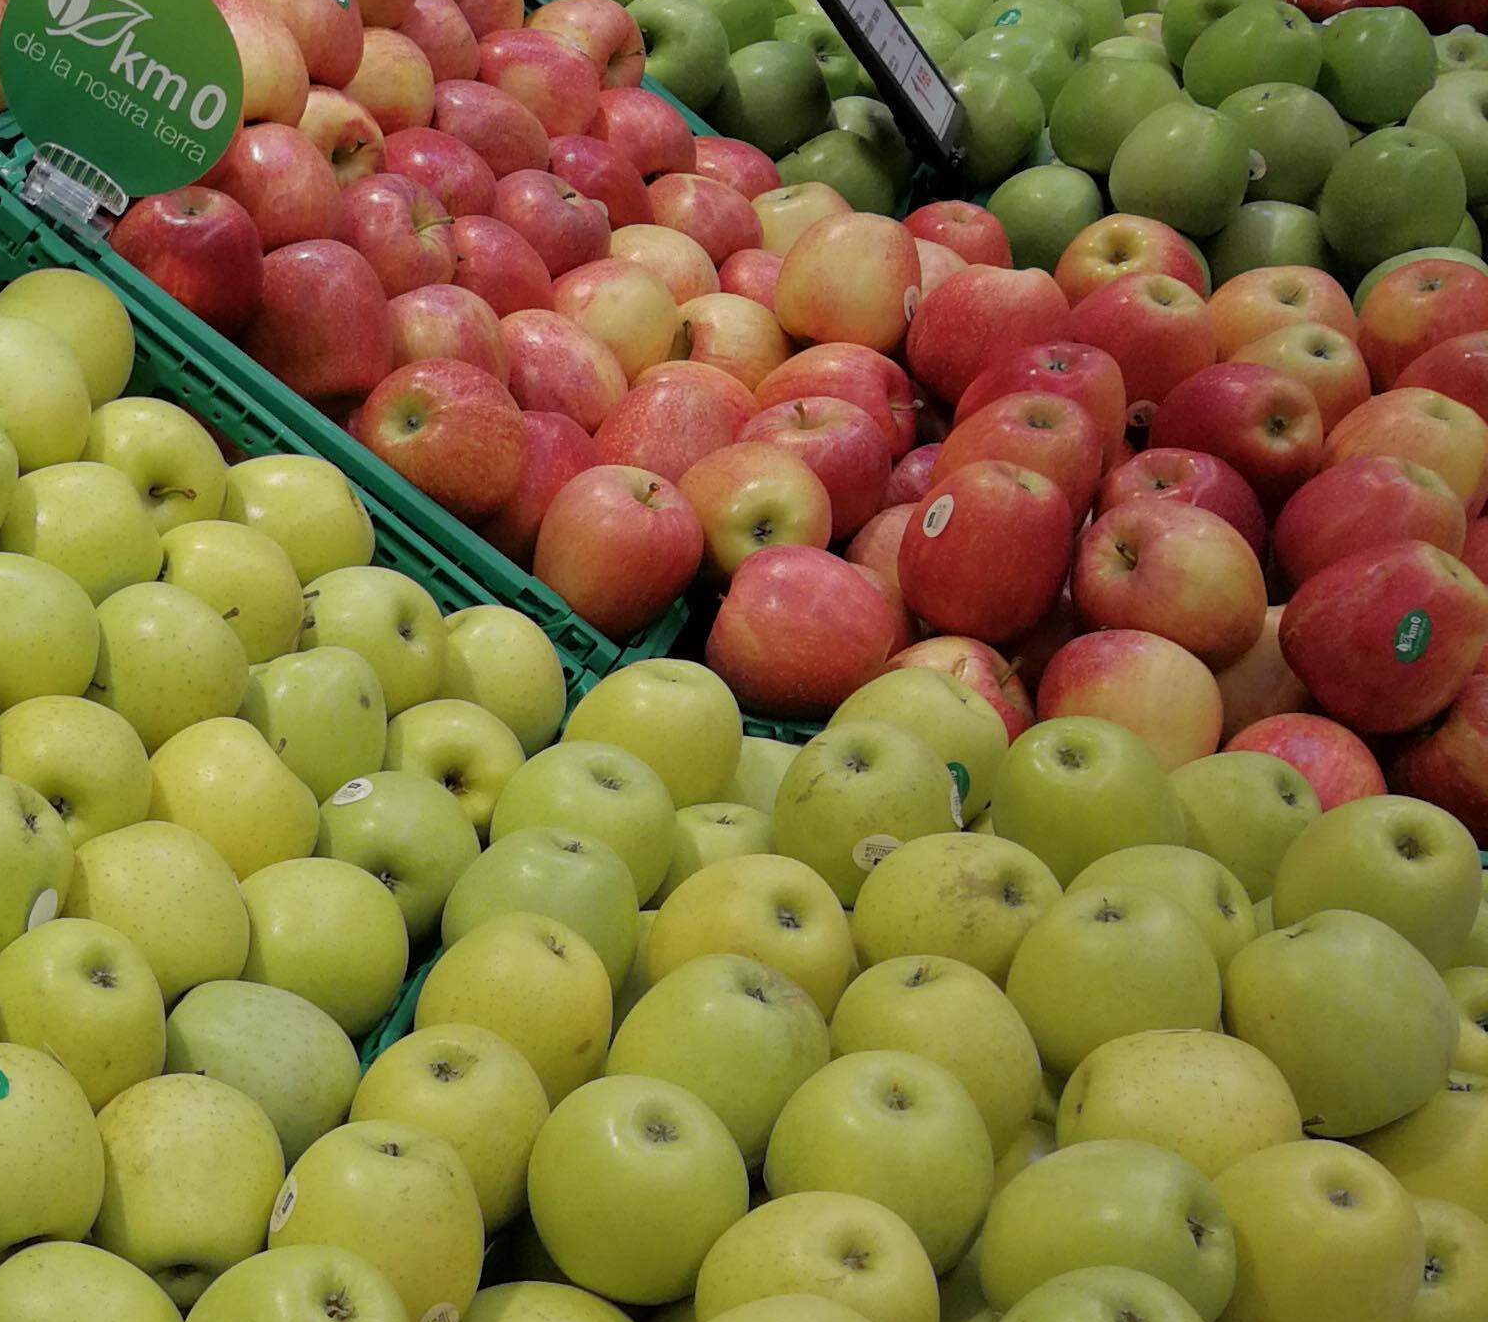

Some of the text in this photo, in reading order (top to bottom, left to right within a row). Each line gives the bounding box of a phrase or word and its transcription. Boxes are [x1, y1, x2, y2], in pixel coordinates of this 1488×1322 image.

[13, 31, 207, 166] de la nostra terra
